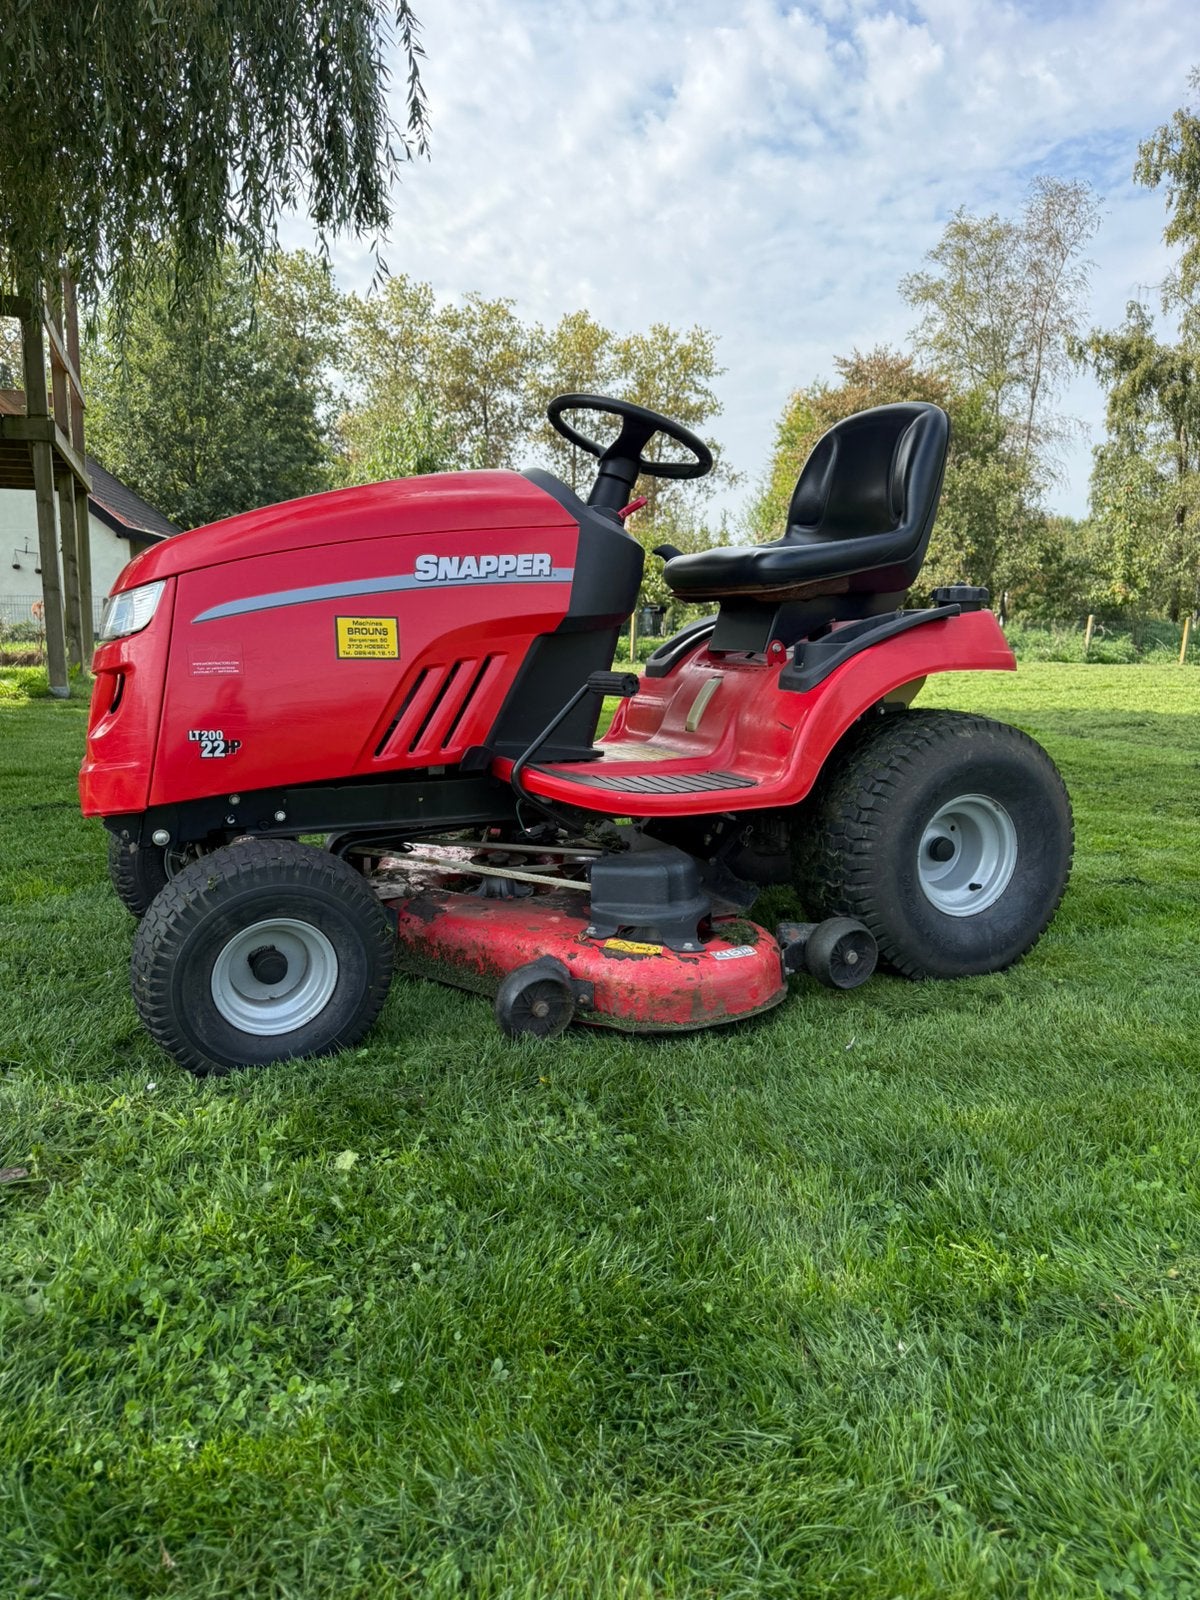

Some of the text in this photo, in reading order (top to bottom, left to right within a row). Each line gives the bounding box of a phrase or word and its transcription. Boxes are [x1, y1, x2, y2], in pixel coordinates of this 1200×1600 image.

[414, 553, 552, 581] SNAPPER
[347, 627, 388, 636] BROUNS
[188, 729, 224, 741] LT200
